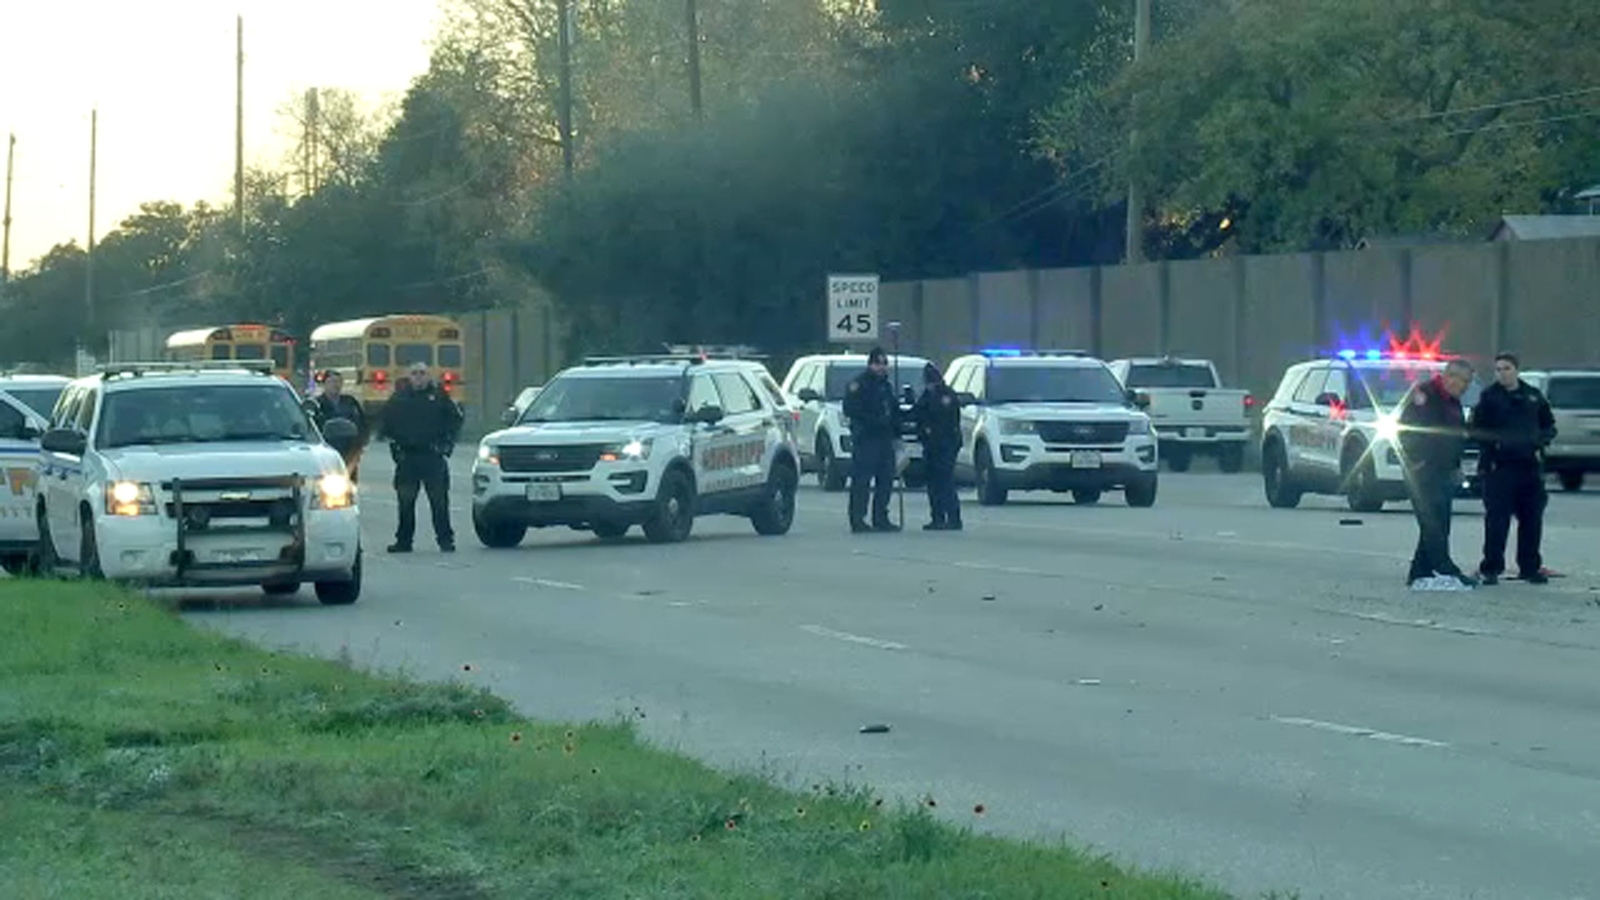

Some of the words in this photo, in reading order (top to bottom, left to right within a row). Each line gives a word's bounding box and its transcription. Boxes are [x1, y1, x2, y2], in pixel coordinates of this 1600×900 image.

[832, 281, 875, 293] SPEED
[836, 297, 871, 309] LIMIT
[836, 314, 871, 333] 45
